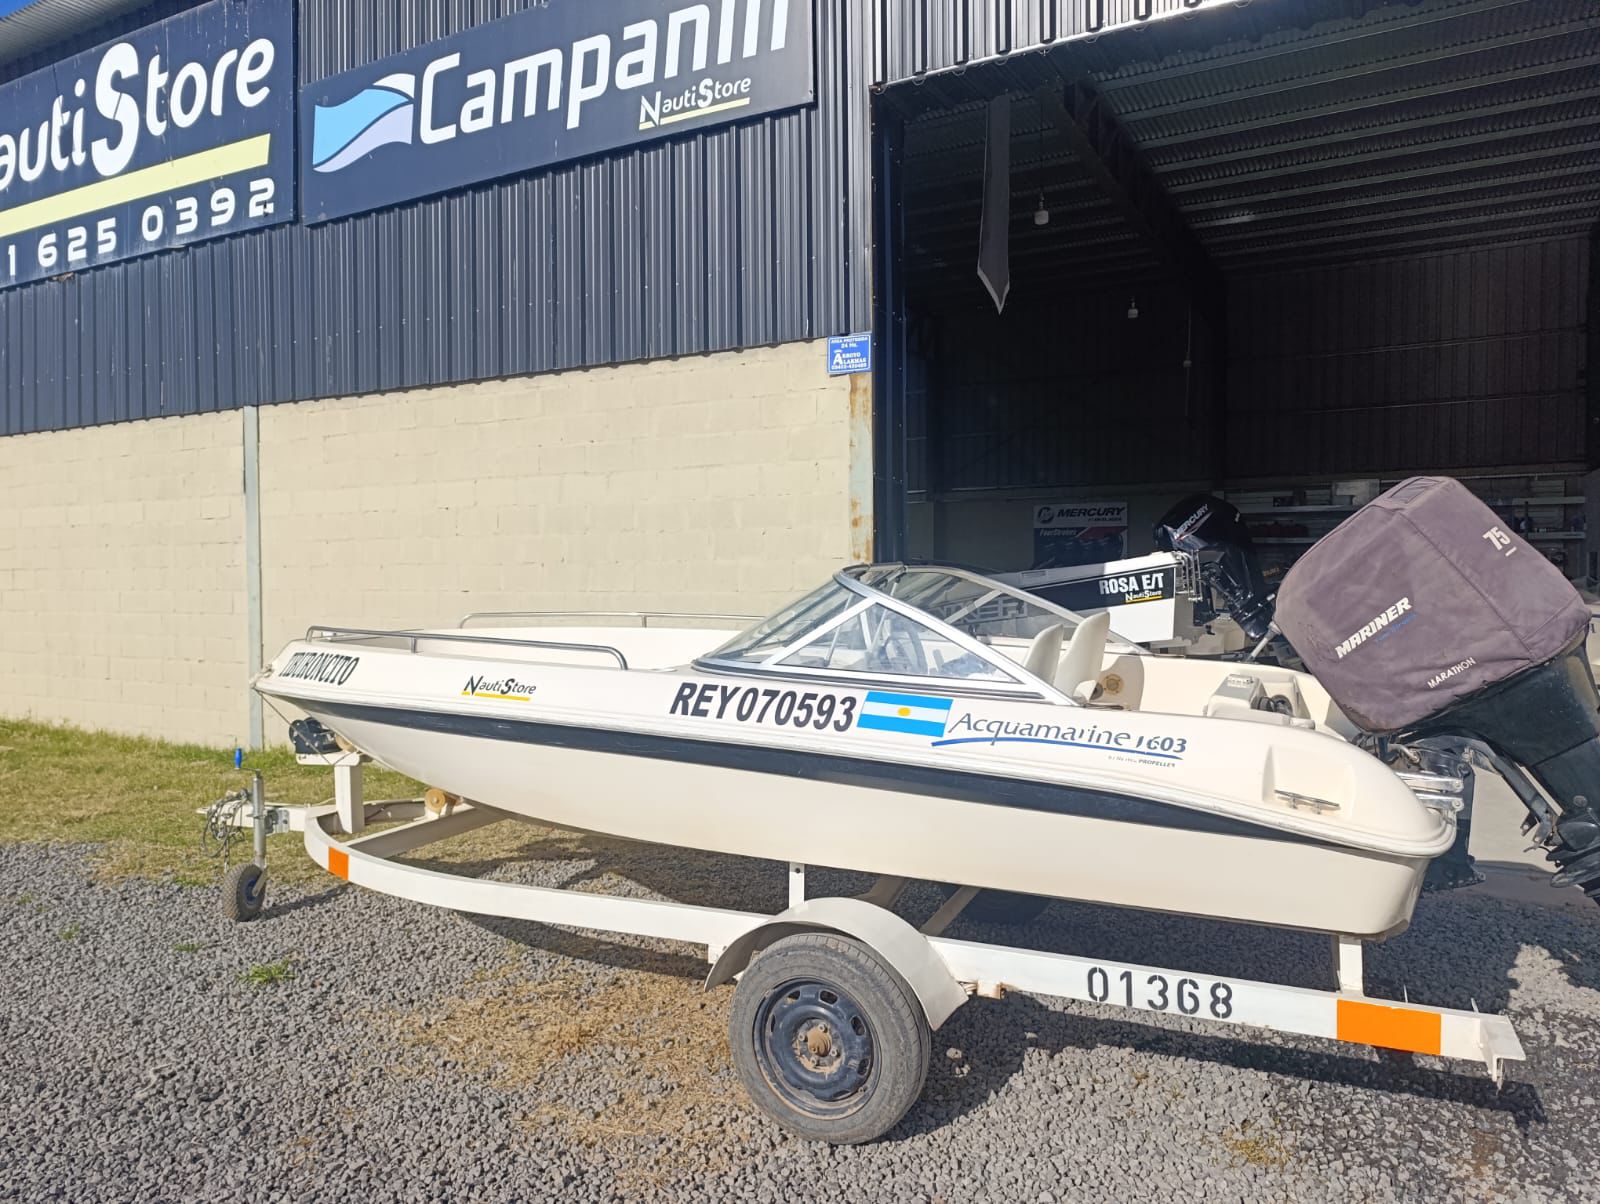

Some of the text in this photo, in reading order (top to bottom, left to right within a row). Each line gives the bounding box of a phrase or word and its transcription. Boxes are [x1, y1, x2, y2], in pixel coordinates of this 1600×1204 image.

[639, 77, 751, 126] NautiStore
[37, 216, 118, 267] 625
[1057, 506, 1126, 518] MERCURY
[1481, 525, 1512, 551] 75
[1098, 575, 1140, 595] ROSA
[1333, 596, 1413, 660] MARINER
[462, 674, 537, 696] NautiStore
[1427, 656, 1477, 690] MARATHON
[669, 681, 857, 732] REY070593
[947, 711, 1188, 754] Acquamarine 1603
[1086, 965, 1233, 1020] 01368
